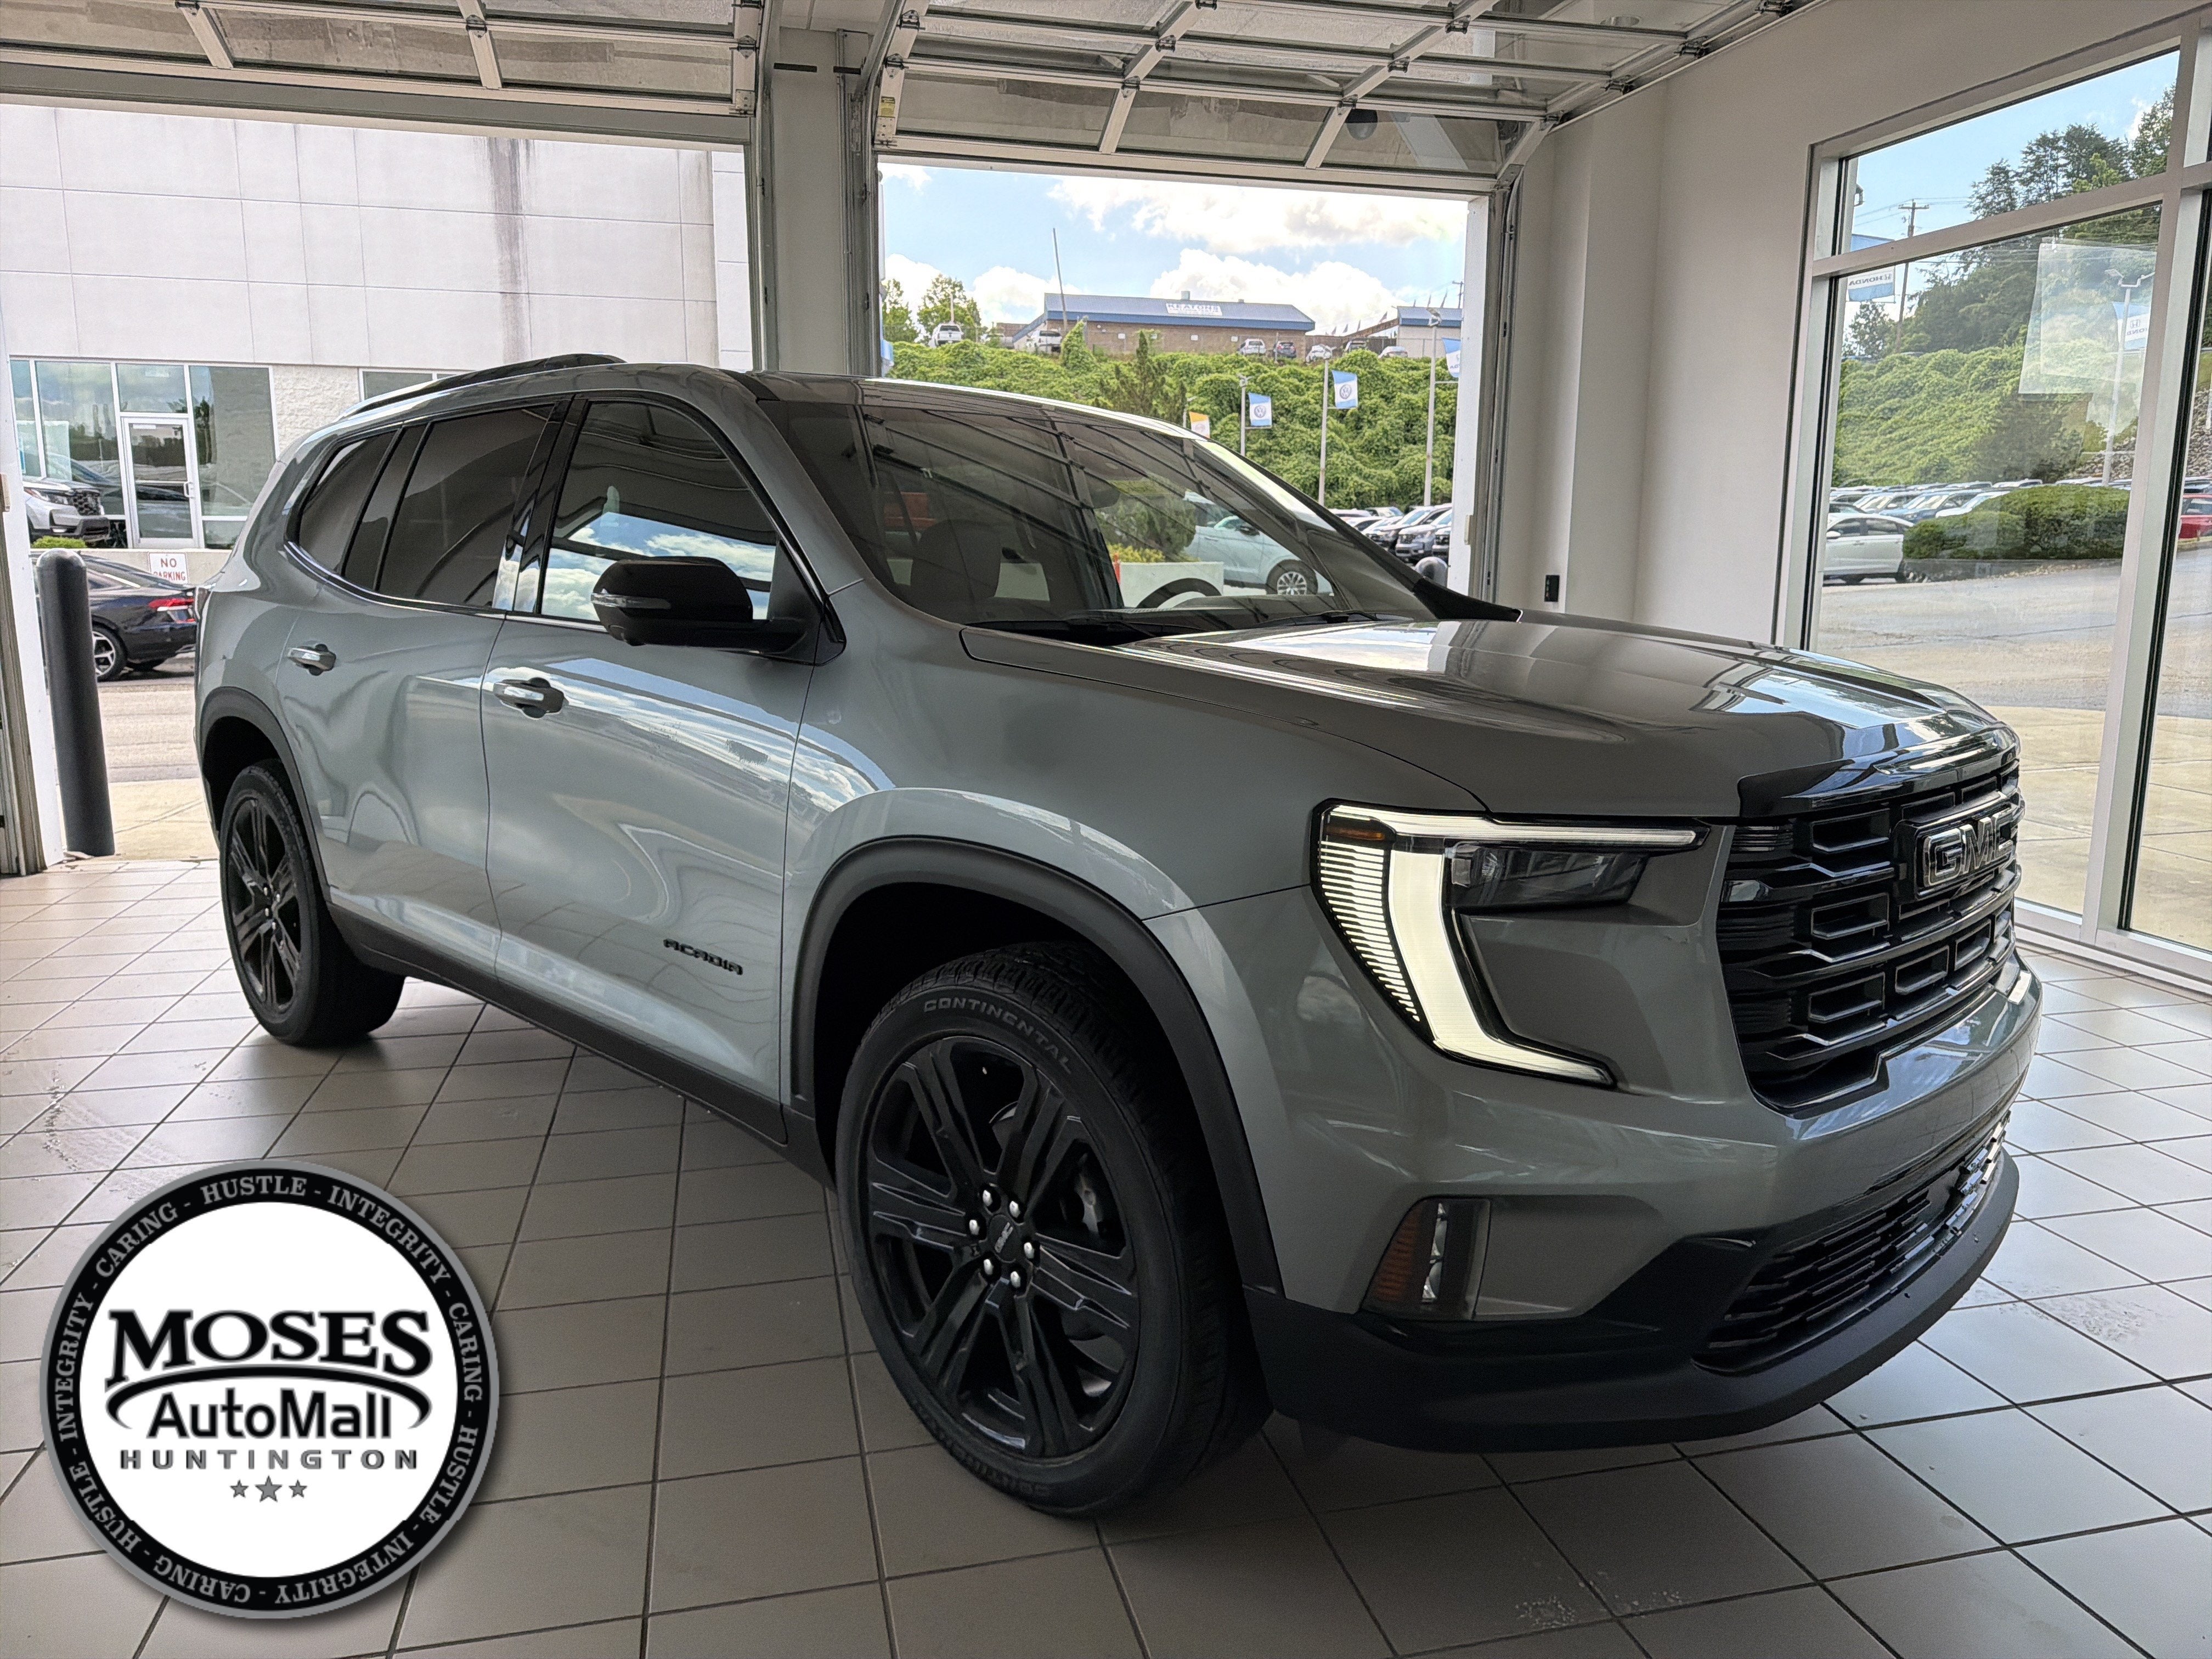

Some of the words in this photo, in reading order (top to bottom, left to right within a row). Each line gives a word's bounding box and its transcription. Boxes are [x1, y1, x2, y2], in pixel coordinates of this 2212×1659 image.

[160, 557, 177, 568] NO
[1923, 807, 2013, 887] GMC
[663, 938, 743, 975] ACADIA
[923, 997, 1071, 1074] CONTINENTAL
